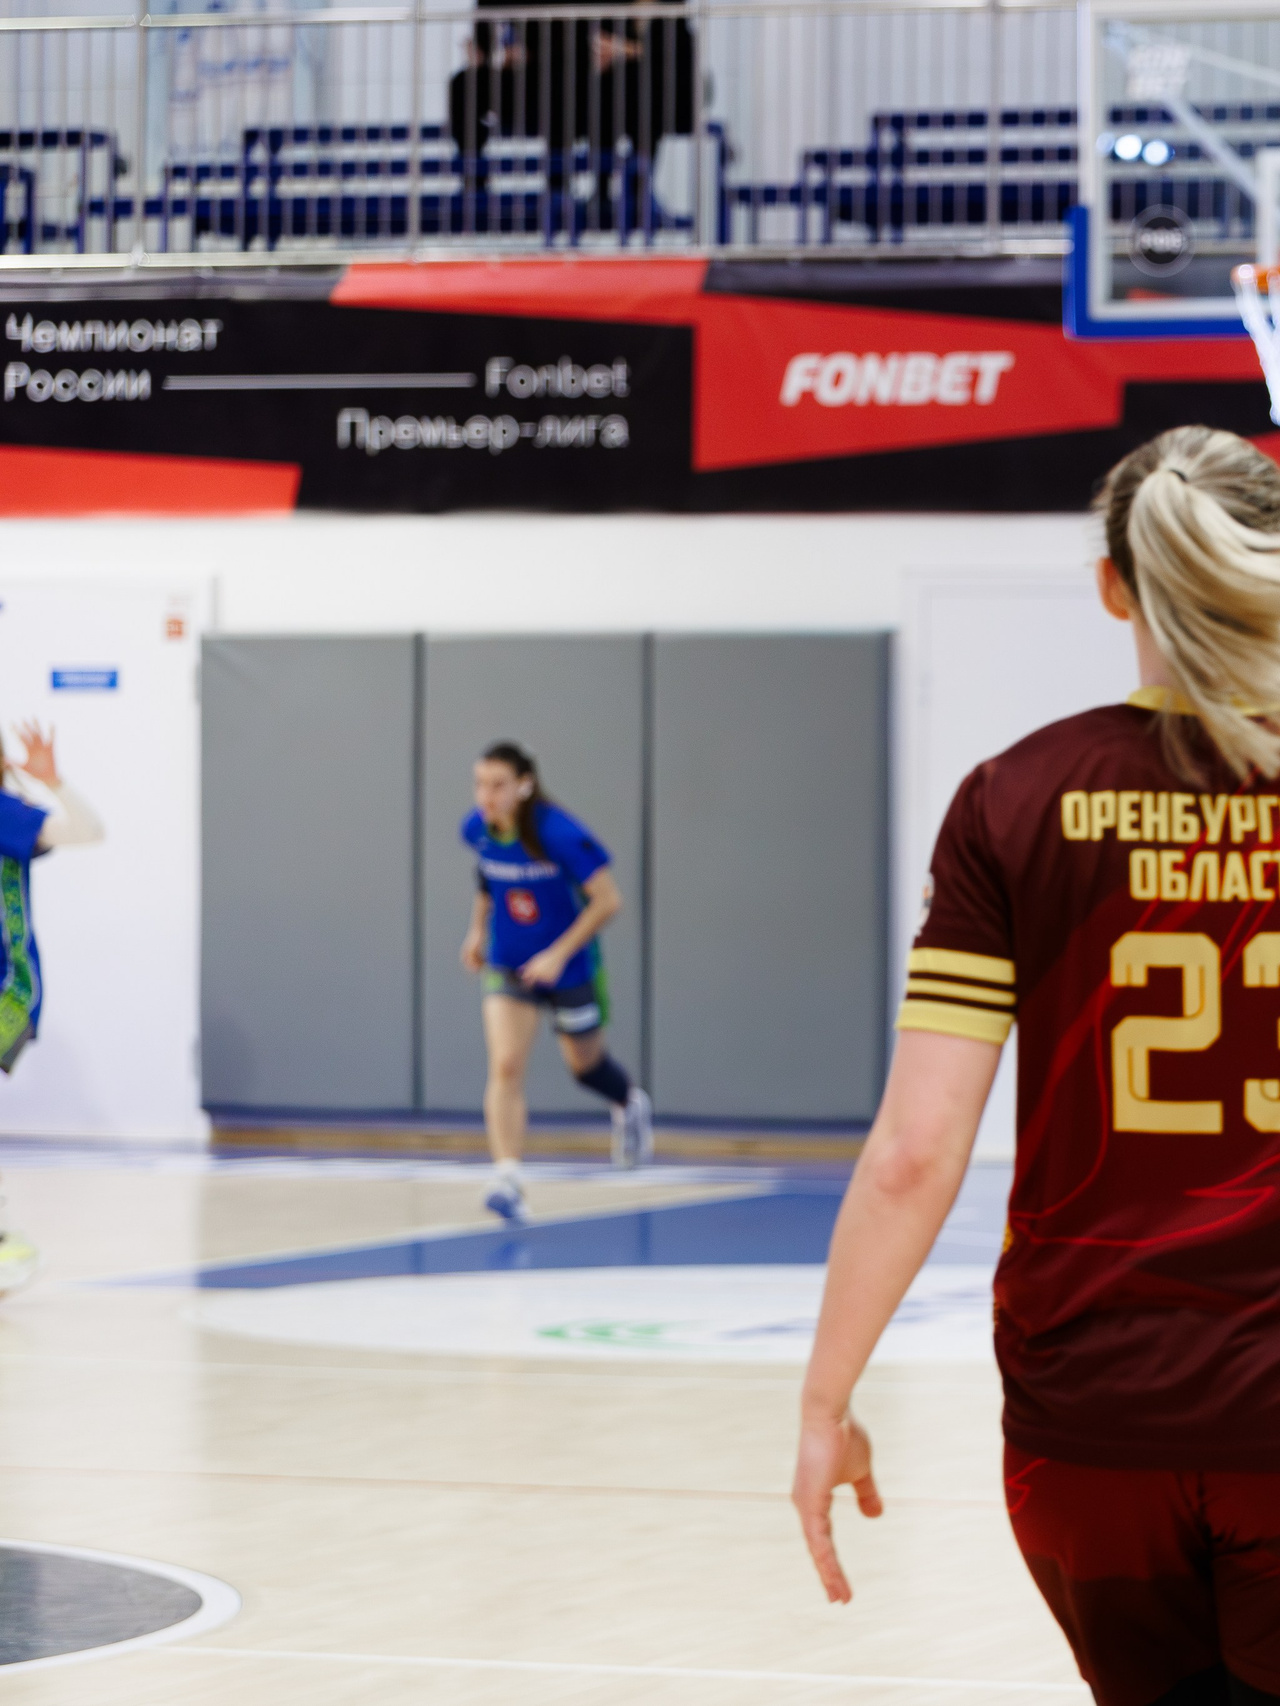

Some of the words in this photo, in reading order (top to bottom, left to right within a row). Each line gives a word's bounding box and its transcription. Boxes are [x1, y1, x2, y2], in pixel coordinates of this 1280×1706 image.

[5, 313, 222, 352] Чемпионат
[4, 361, 151, 401] России
[485, 356, 630, 397] Fonbet
[780, 351, 1014, 407] FONBET
